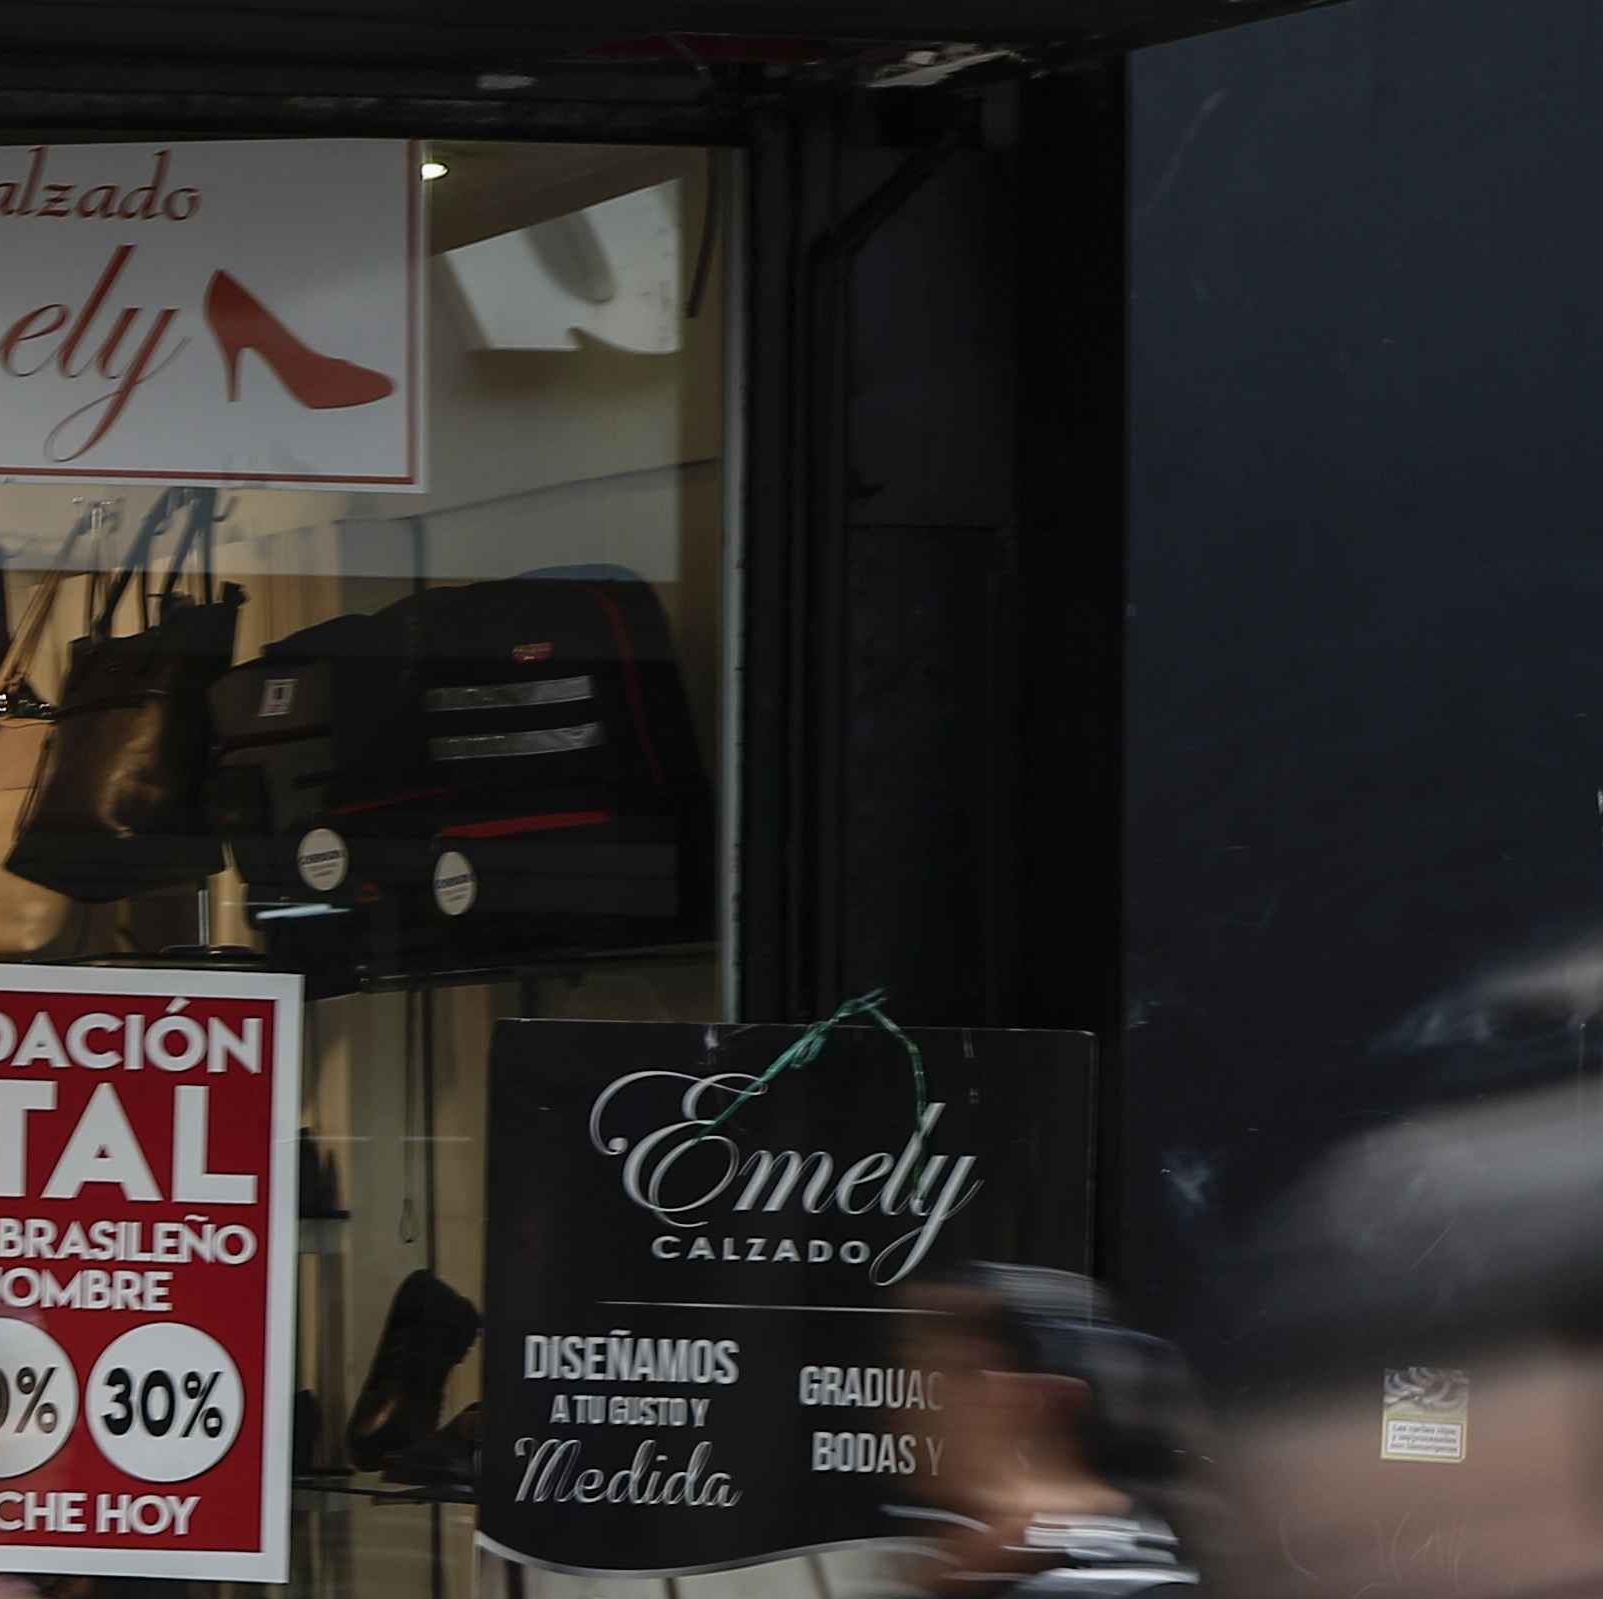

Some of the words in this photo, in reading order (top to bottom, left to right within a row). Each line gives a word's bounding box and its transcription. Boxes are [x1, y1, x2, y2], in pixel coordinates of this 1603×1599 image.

[589, 1070, 986, 1286] Emely
[651, 1235, 871, 1264] CALZADO
[523, 1329, 741, 1385] DISEÑAMOS
[101, 1367, 224, 1439] 30%
[549, 1393, 571, 1424] A
[571, 1394, 607, 1425] TU
[607, 1395, 689, 1427] GUSTO
[689, 1397, 713, 1428] Y
[798, 1365, 945, 1413] GRADUAC
[514, 1436, 743, 1508] Medida
[811, 1430, 917, 1476] BODAS
[96, 1493, 201, 1536] HOY
